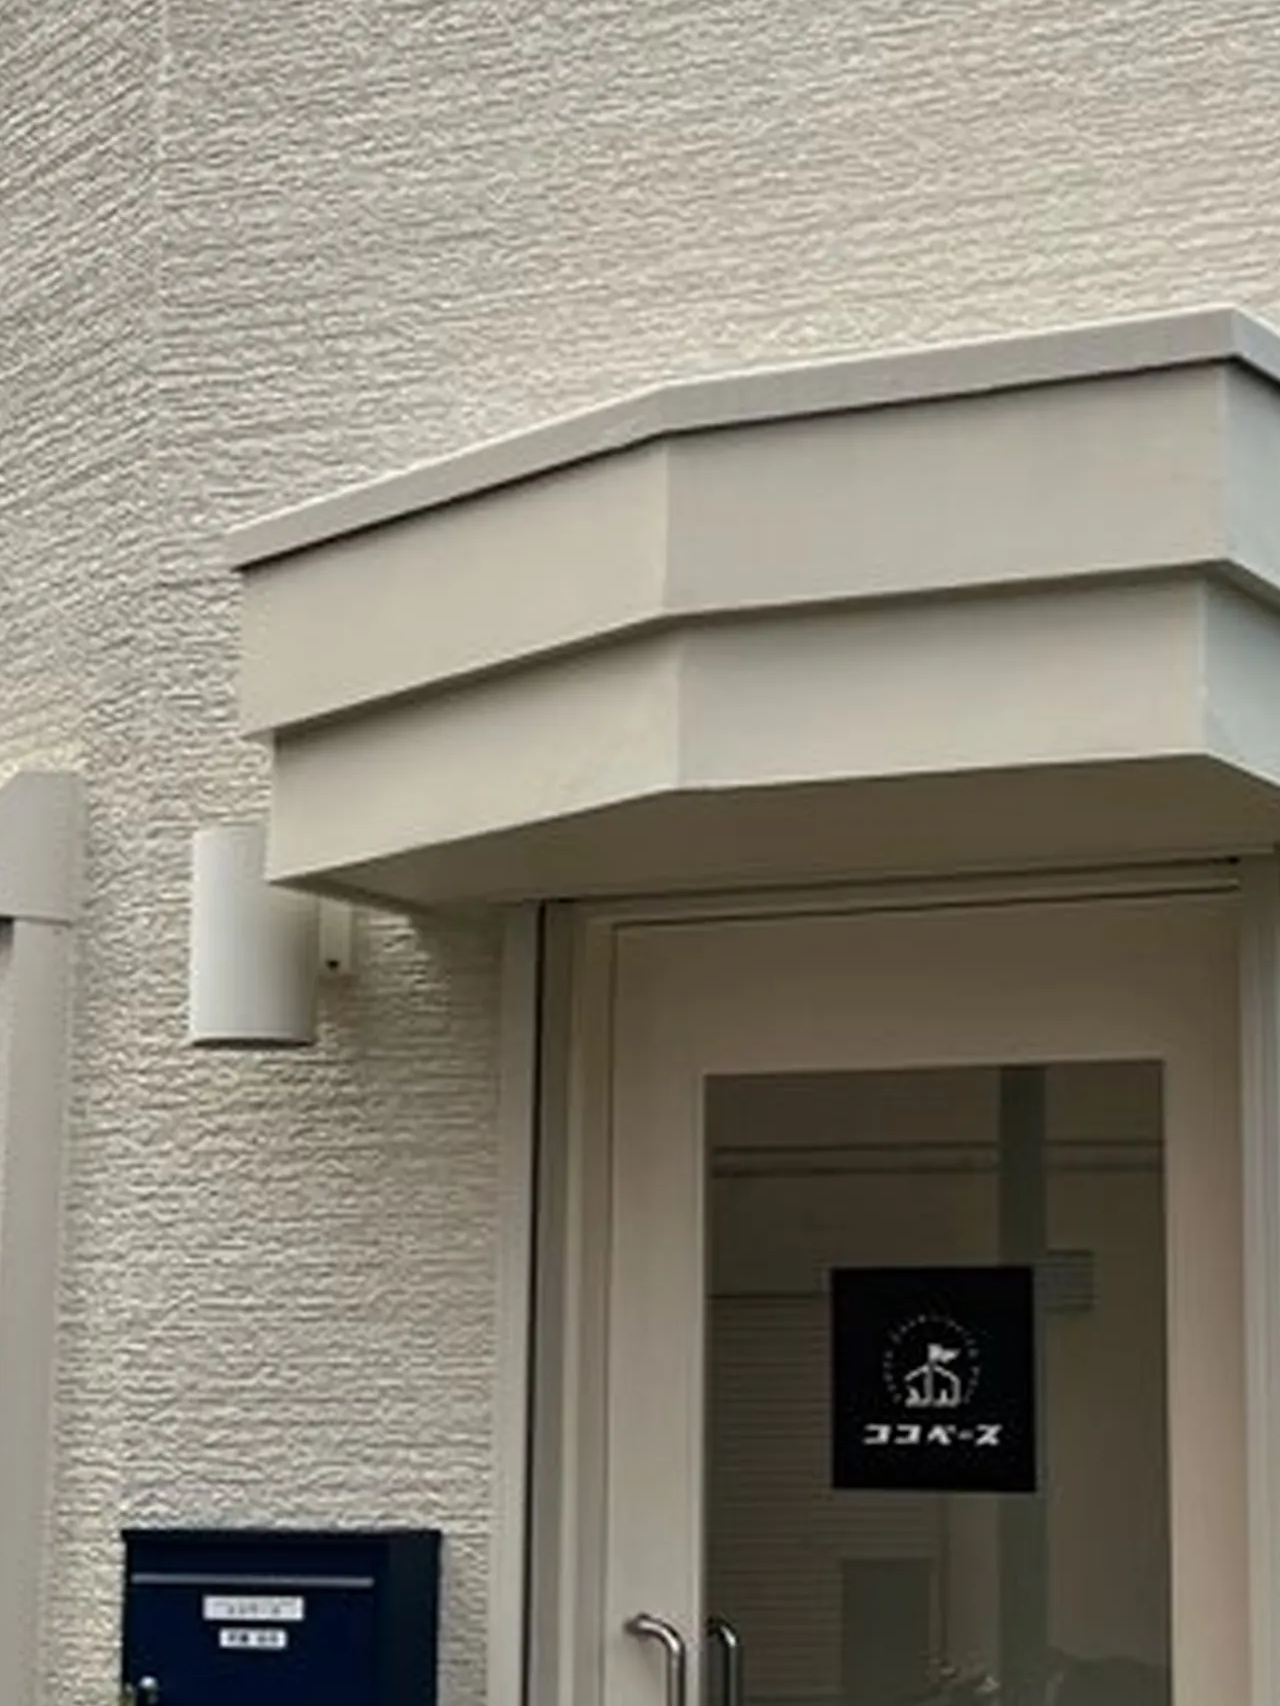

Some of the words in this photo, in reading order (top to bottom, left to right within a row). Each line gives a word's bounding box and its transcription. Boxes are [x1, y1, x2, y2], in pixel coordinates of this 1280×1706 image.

[863, 1424, 1003, 1445] ココベース
